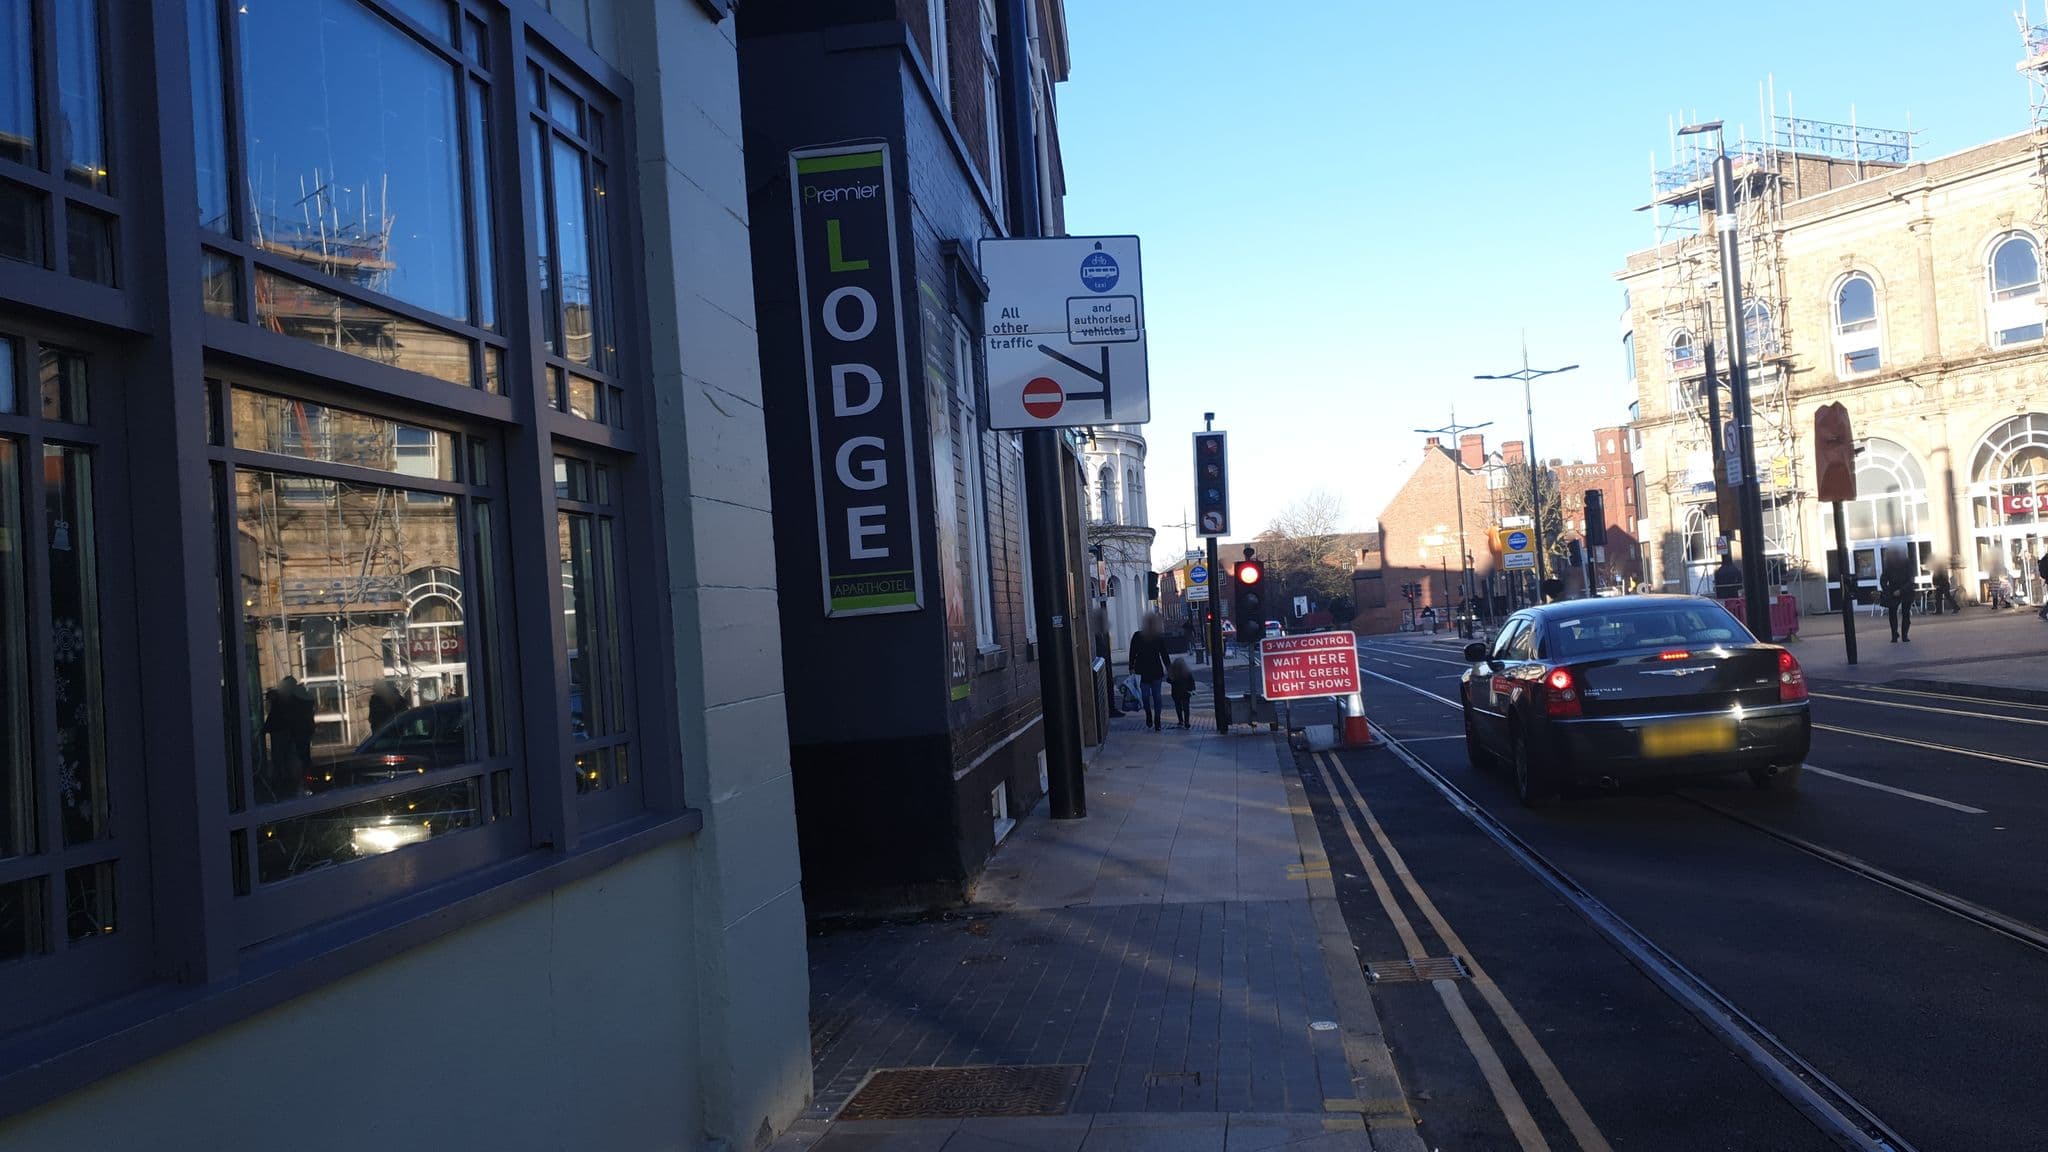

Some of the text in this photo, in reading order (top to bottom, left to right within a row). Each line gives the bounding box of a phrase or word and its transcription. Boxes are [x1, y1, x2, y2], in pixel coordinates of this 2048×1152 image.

[1001, 307, 1020, 319] All
[1092, 303, 1112, 313] and
[1074, 314, 1131, 325] authorised
[993, 322, 1029, 334] other
[1081, 326, 1126, 337] vehicles
[990, 336, 1033, 350] traffic
[822, 219, 889, 560] LODGE
[833, 579, 913, 597] APARTHOTEL
[1266, 636, 1349, 650] 3-WAY CONTROL
[1273, 653, 1347, 667] WAIT HERE
[1272, 666, 1349, 680] UNTIL GREEN
[1272, 678, 1352, 693] LIGHT SHOWS
